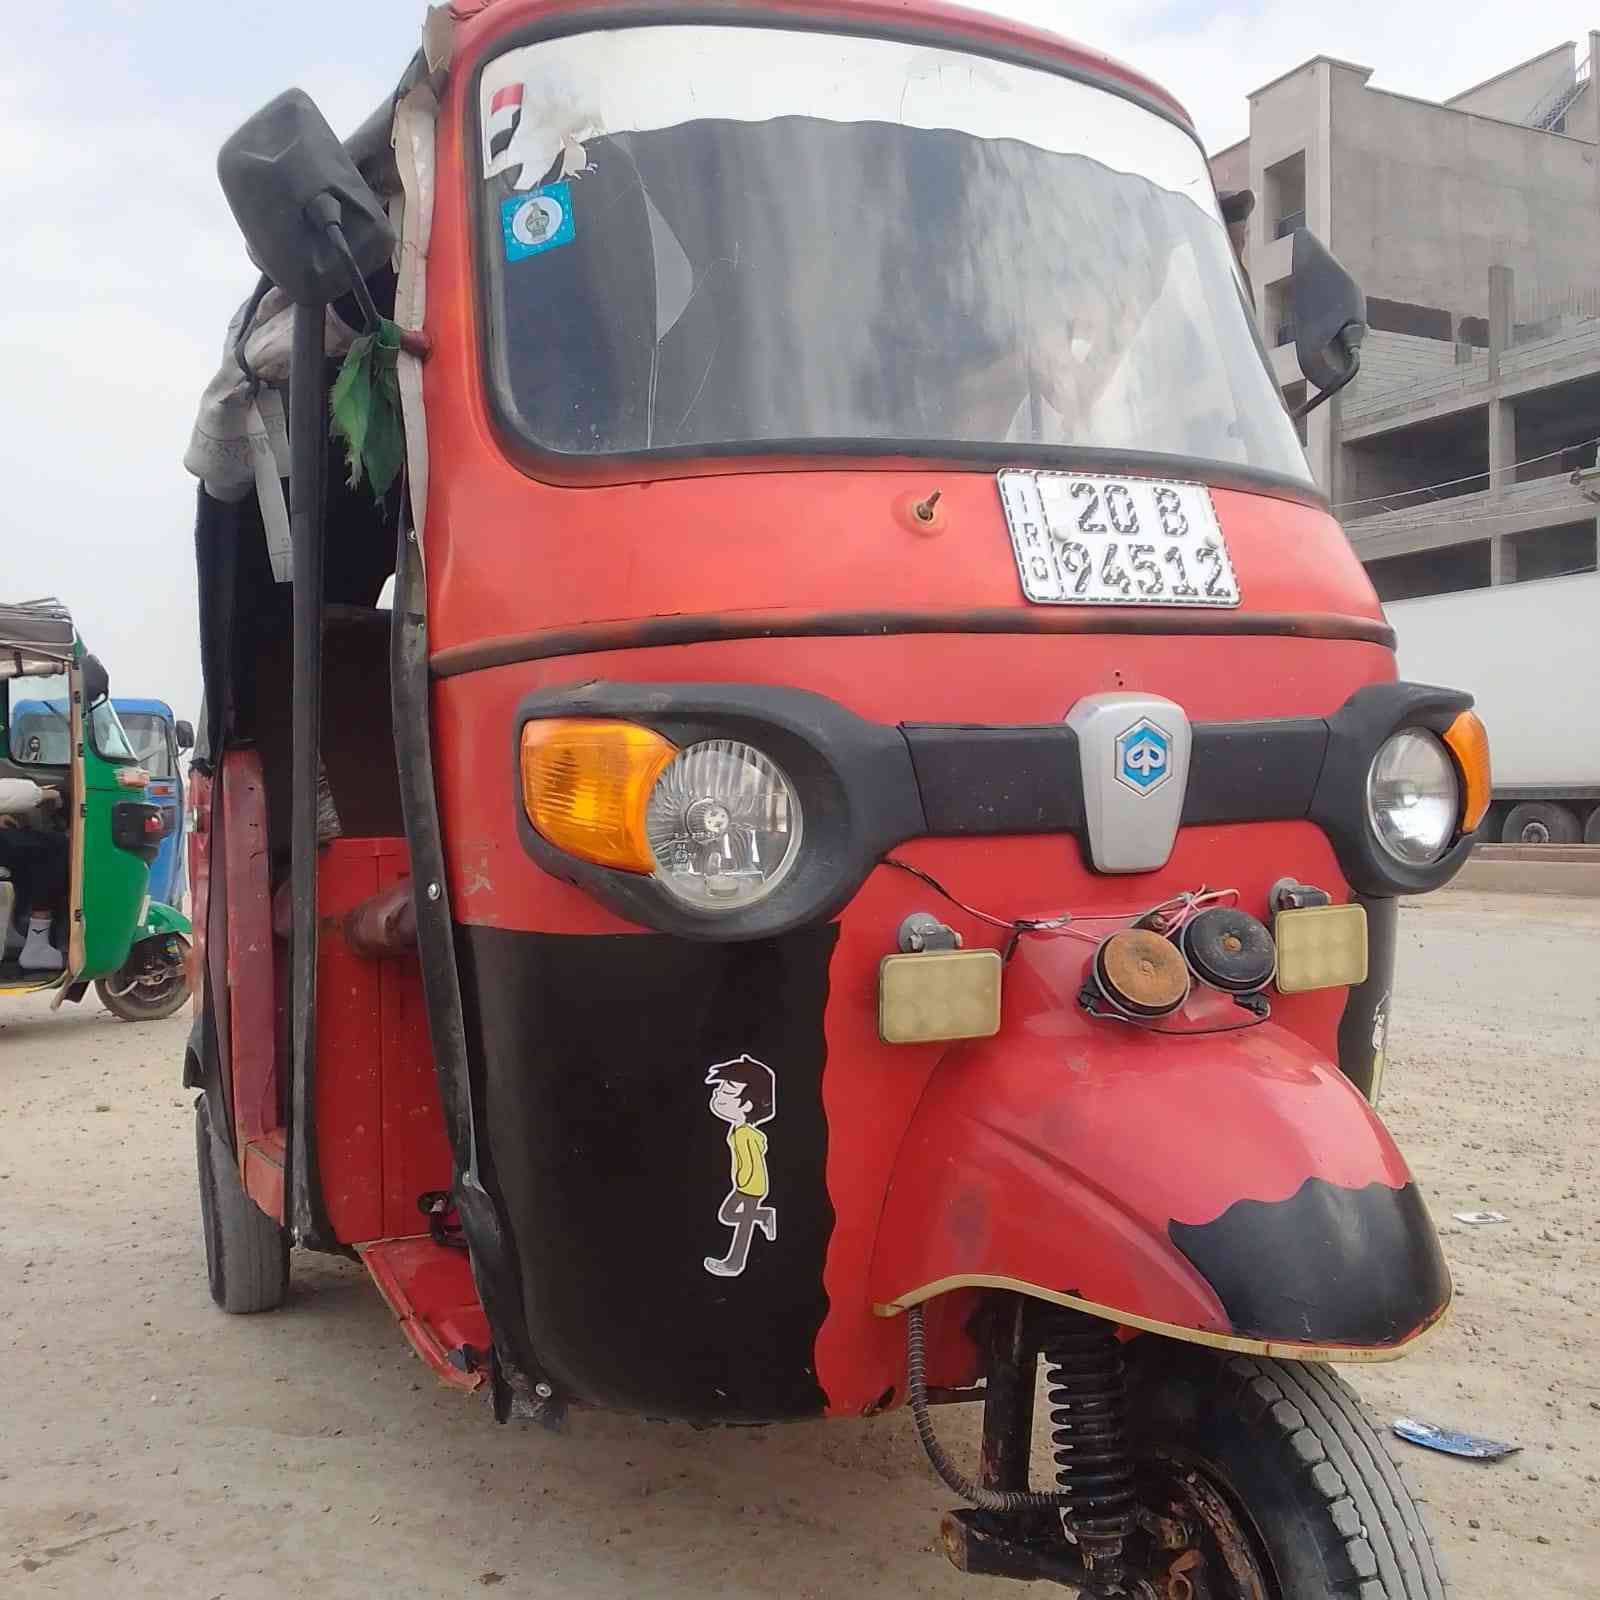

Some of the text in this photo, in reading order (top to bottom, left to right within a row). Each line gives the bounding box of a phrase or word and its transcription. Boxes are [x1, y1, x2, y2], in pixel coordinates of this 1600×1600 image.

[1020, 490, 1049, 580] IRQ
[1070, 482, 1140, 534] 20
[1061, 541, 1232, 597] 94512
